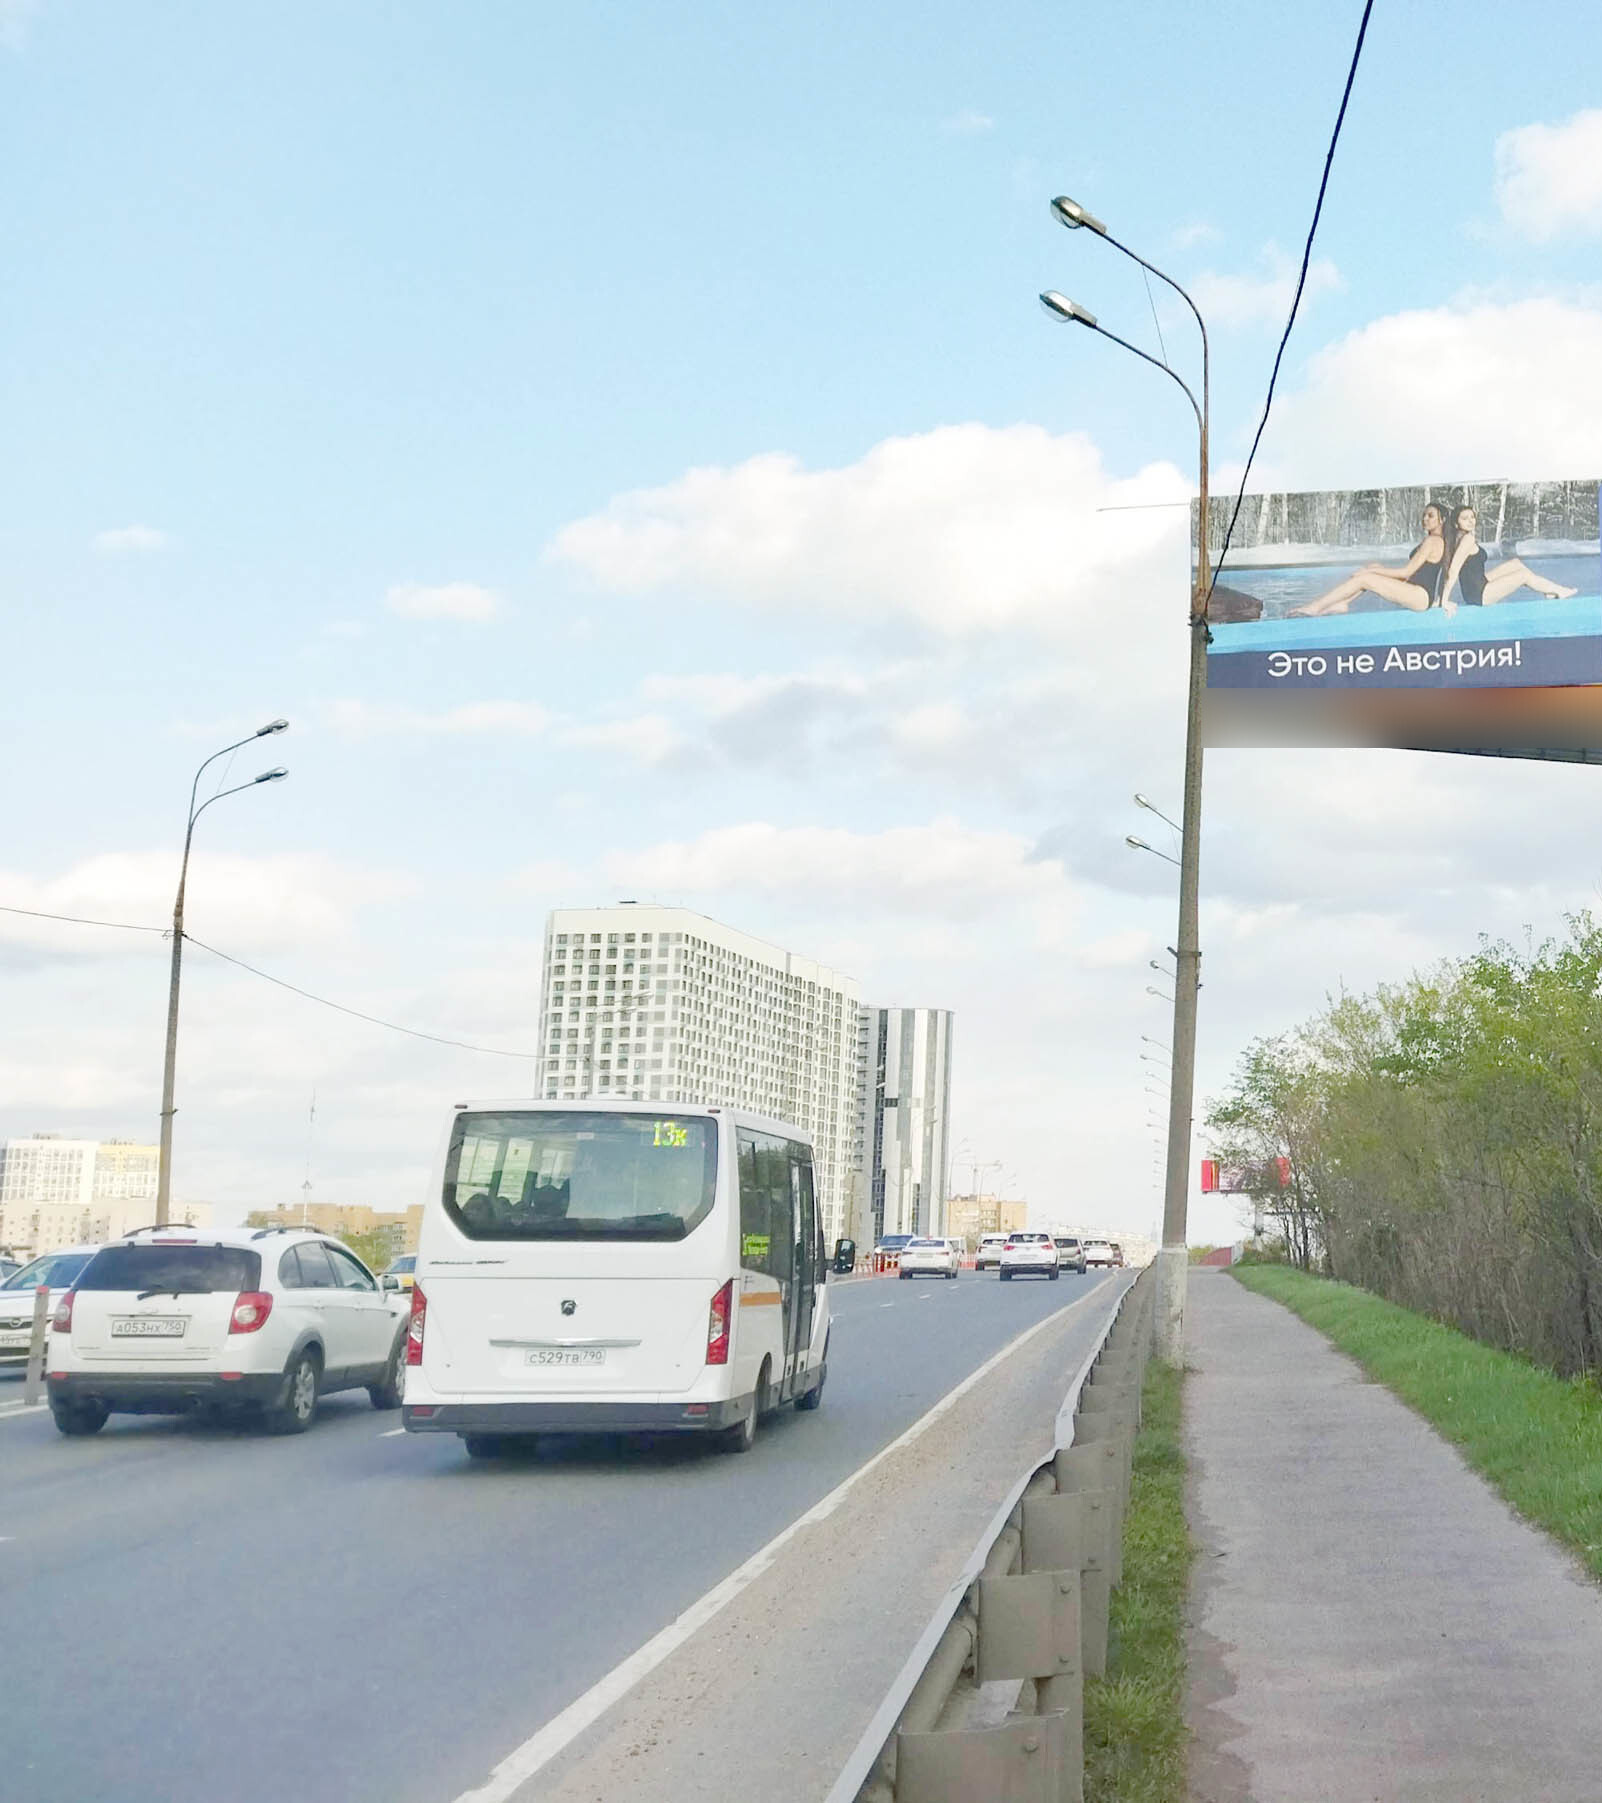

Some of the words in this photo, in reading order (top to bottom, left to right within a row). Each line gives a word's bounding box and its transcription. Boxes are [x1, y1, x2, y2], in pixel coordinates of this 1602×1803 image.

[1267, 651, 1327, 677] Это
[1336, 655, 1374, 675] не
[1383, 641, 1522, 674] Австрия!
